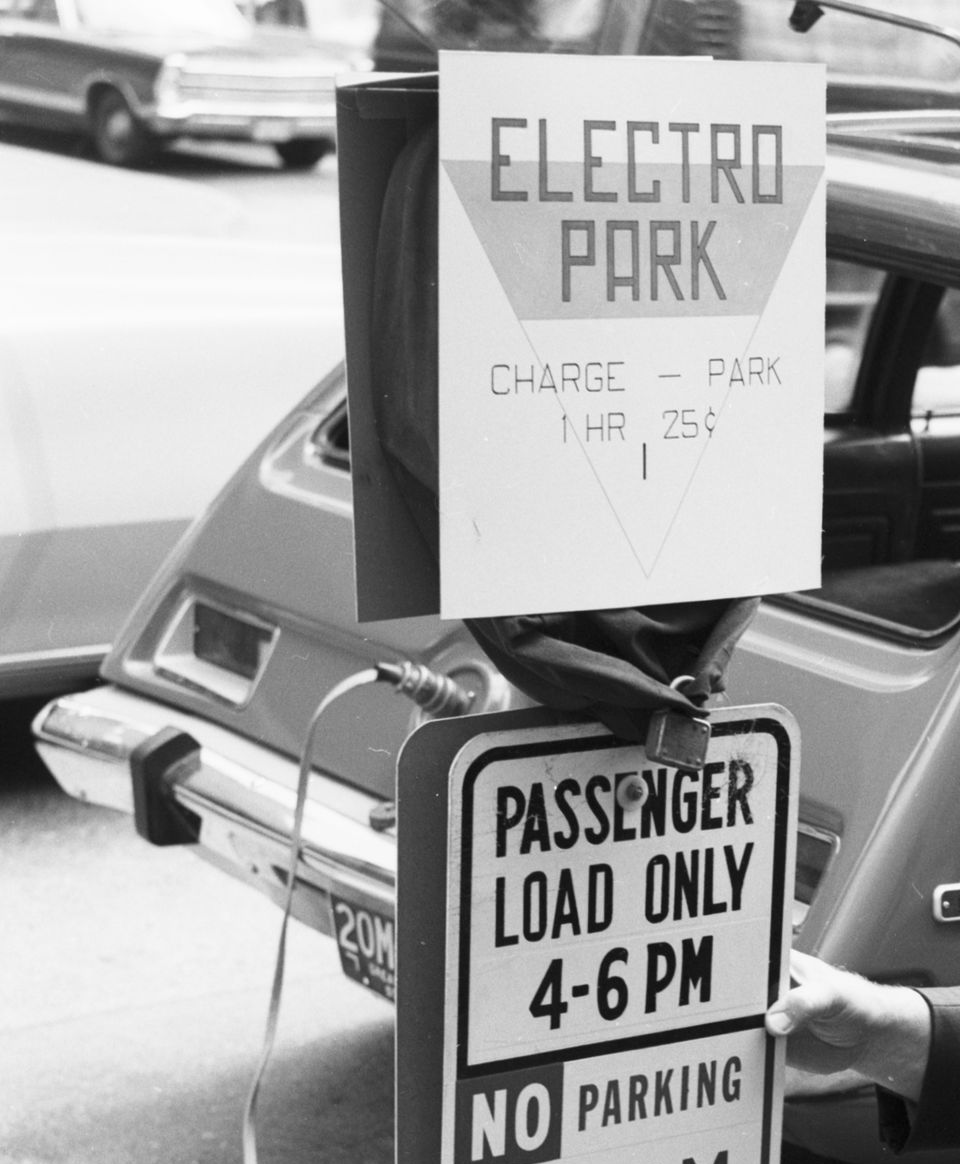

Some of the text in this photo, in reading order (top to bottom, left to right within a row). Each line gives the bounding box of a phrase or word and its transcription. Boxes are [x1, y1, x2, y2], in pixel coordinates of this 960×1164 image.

[490, 117, 784, 205] ELECTRO
[561, 219, 727, 303] PARK
[490, 360, 627, 396] CHARGE
[708, 356, 783, 387] PARK
[561, 406, 716, 444] 1 HR 25¢
[495, 759, 755, 858] PASSENGER
[494, 841, 755, 949] LOAD ONLY
[470, 1055, 743, 1162] NO PARKING
